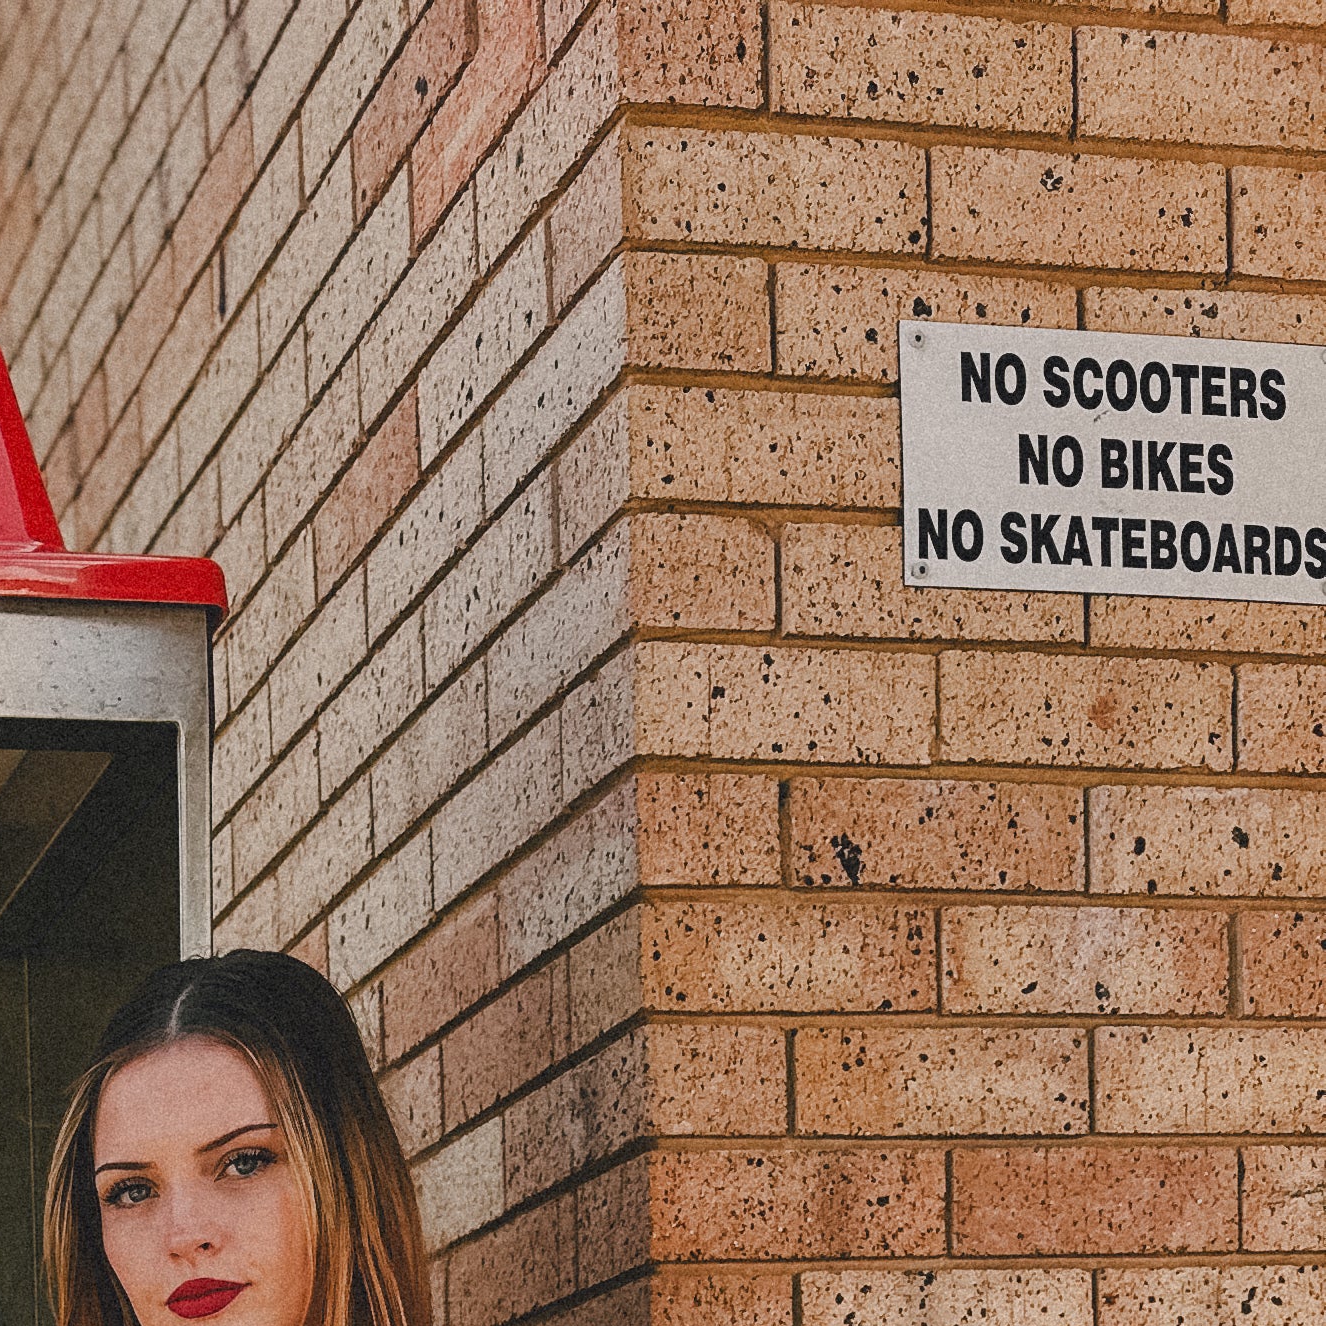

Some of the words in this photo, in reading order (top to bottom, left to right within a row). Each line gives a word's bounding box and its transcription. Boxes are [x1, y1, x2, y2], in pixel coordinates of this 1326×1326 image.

[960, 351, 1027, 405] NO
[1043, 355, 1287, 421] SCOOTERS
[1018, 433, 1084, 488] NO
[1100, 437, 1234, 496] BIKES
[918, 507, 984, 562] NO
[1000, 511, 1326, 580] SKATEBOARDS
